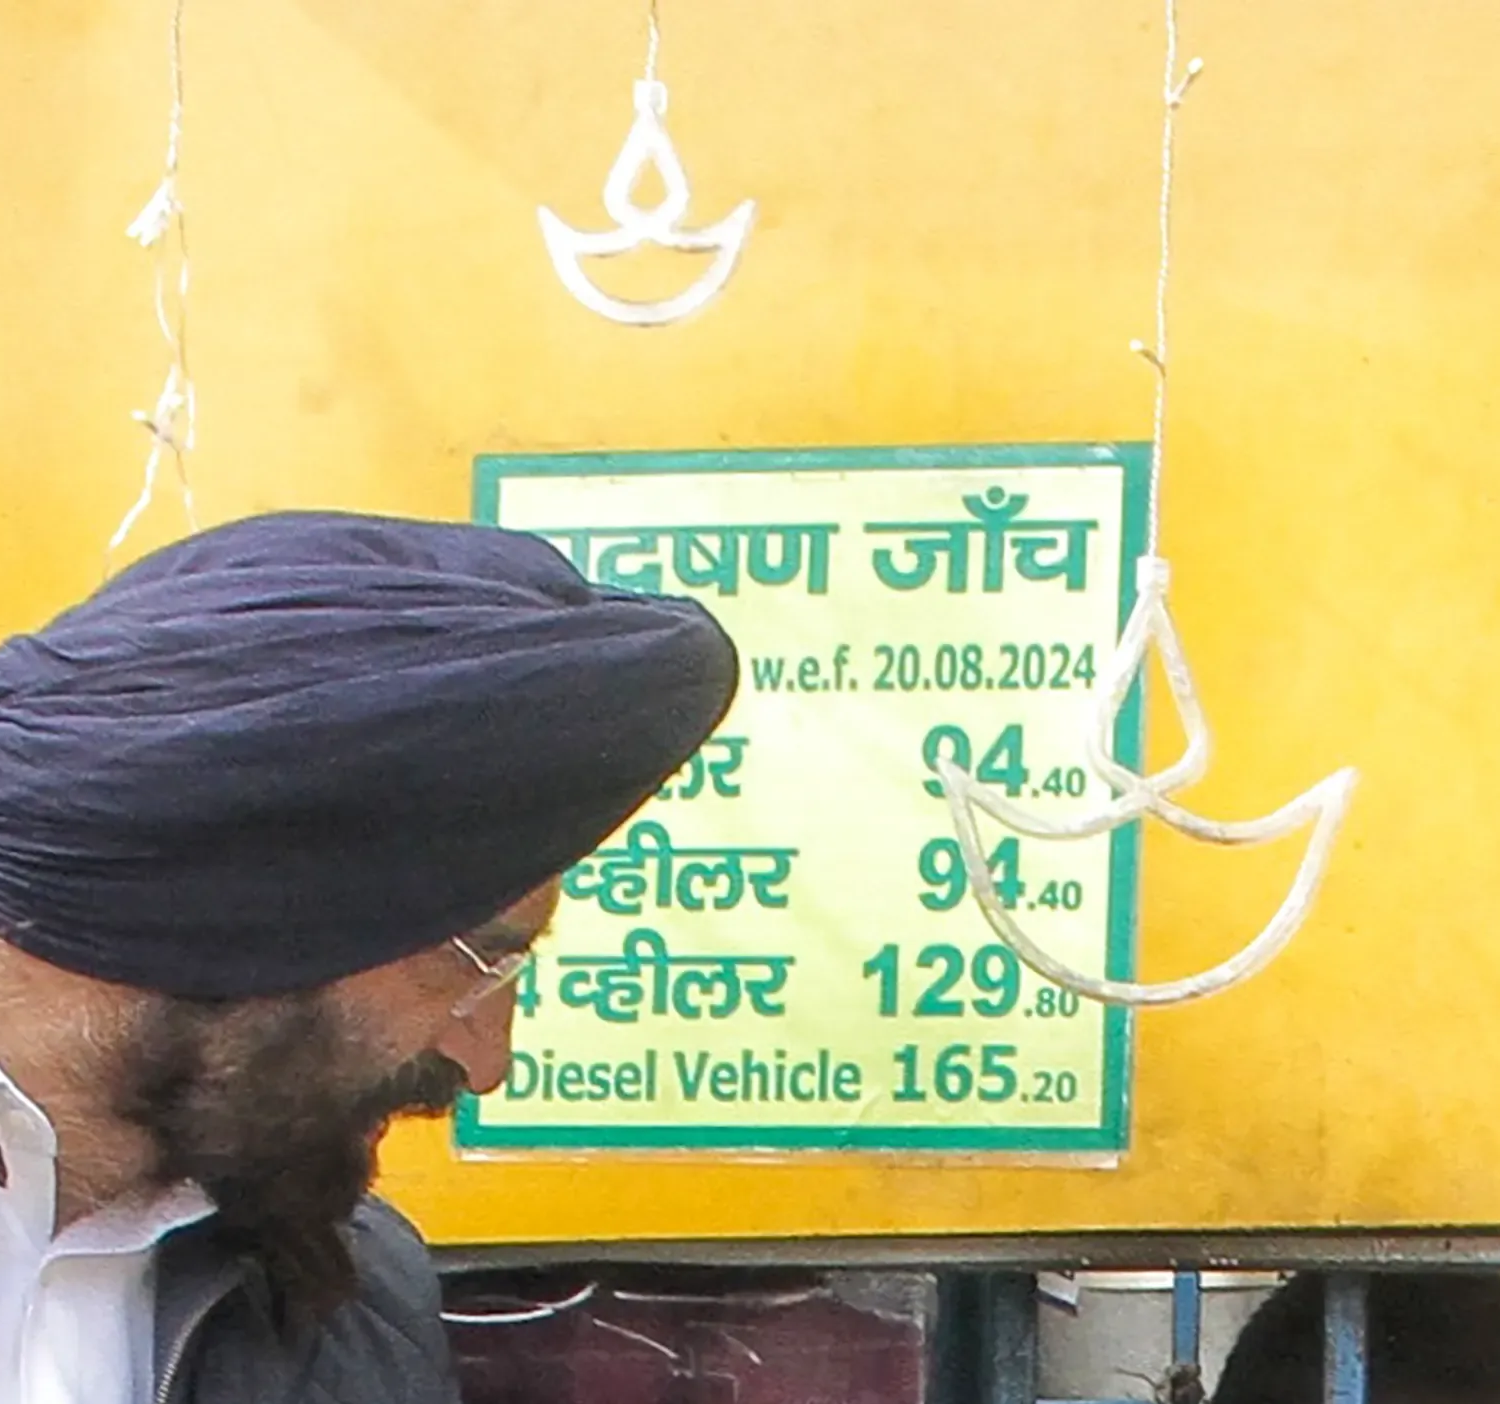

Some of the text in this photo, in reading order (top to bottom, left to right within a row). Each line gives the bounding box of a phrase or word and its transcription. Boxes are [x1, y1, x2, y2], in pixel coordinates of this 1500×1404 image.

[863, 485, 1099, 593] जाँच
[751, 643, 1097, 693] w.e.f. 20.08.2024
[921, 724, 1087, 798] 94.40
[918, 837, 1083, 912] 94.40
[557, 927, 796, 1023] व्हीलर
[862, 943, 1080, 1018] 129.80
[504, 1043, 1078, 1103] Diesel Vehicle 165.20
